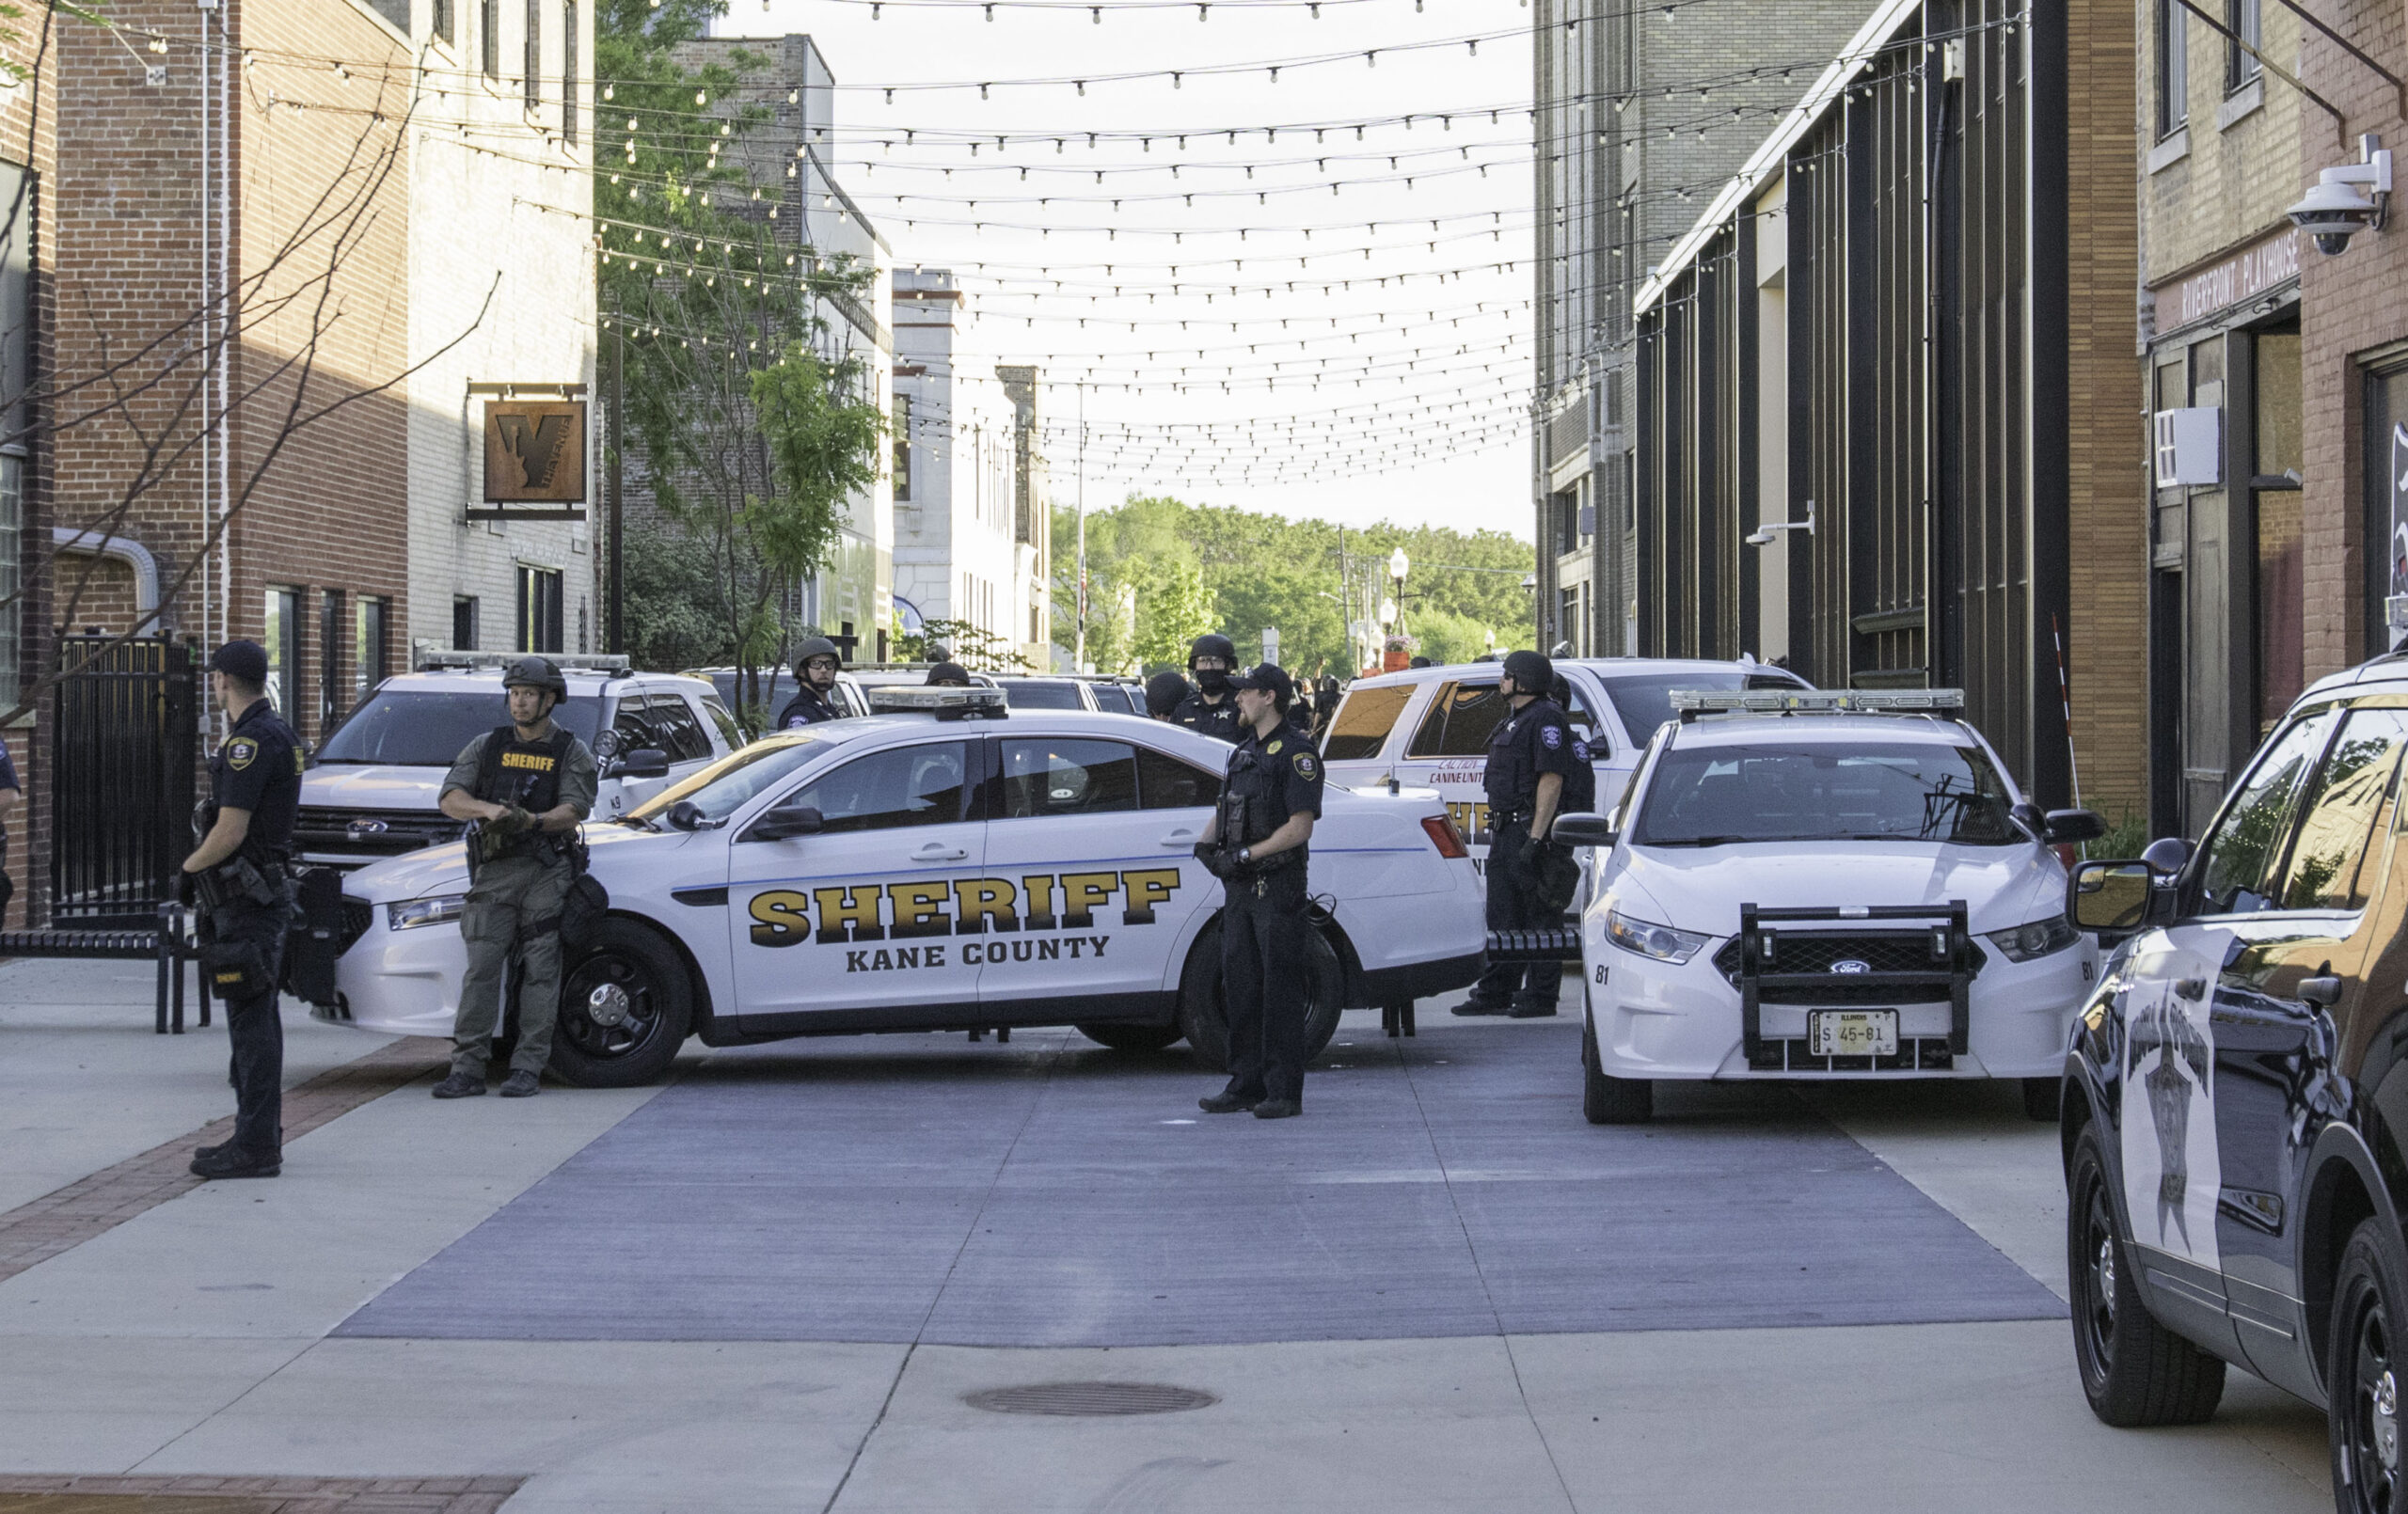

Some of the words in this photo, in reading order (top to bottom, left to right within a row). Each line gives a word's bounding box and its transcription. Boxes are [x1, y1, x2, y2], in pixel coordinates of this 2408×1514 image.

[2182, 261, 2236, 321] RIVERFRONT
[2243, 228, 2299, 296] PLAYHOUSE
[501, 752, 555, 771] SHERIFF
[748, 867, 1181, 948] SHERIFF
[847, 945, 945, 973] KANE
[962, 936, 1111, 965] COUNTY
[1595, 964, 1609, 986] 81
[2082, 960, 2094, 981] 81
[1840, 1027, 1883, 1042] 45-81
